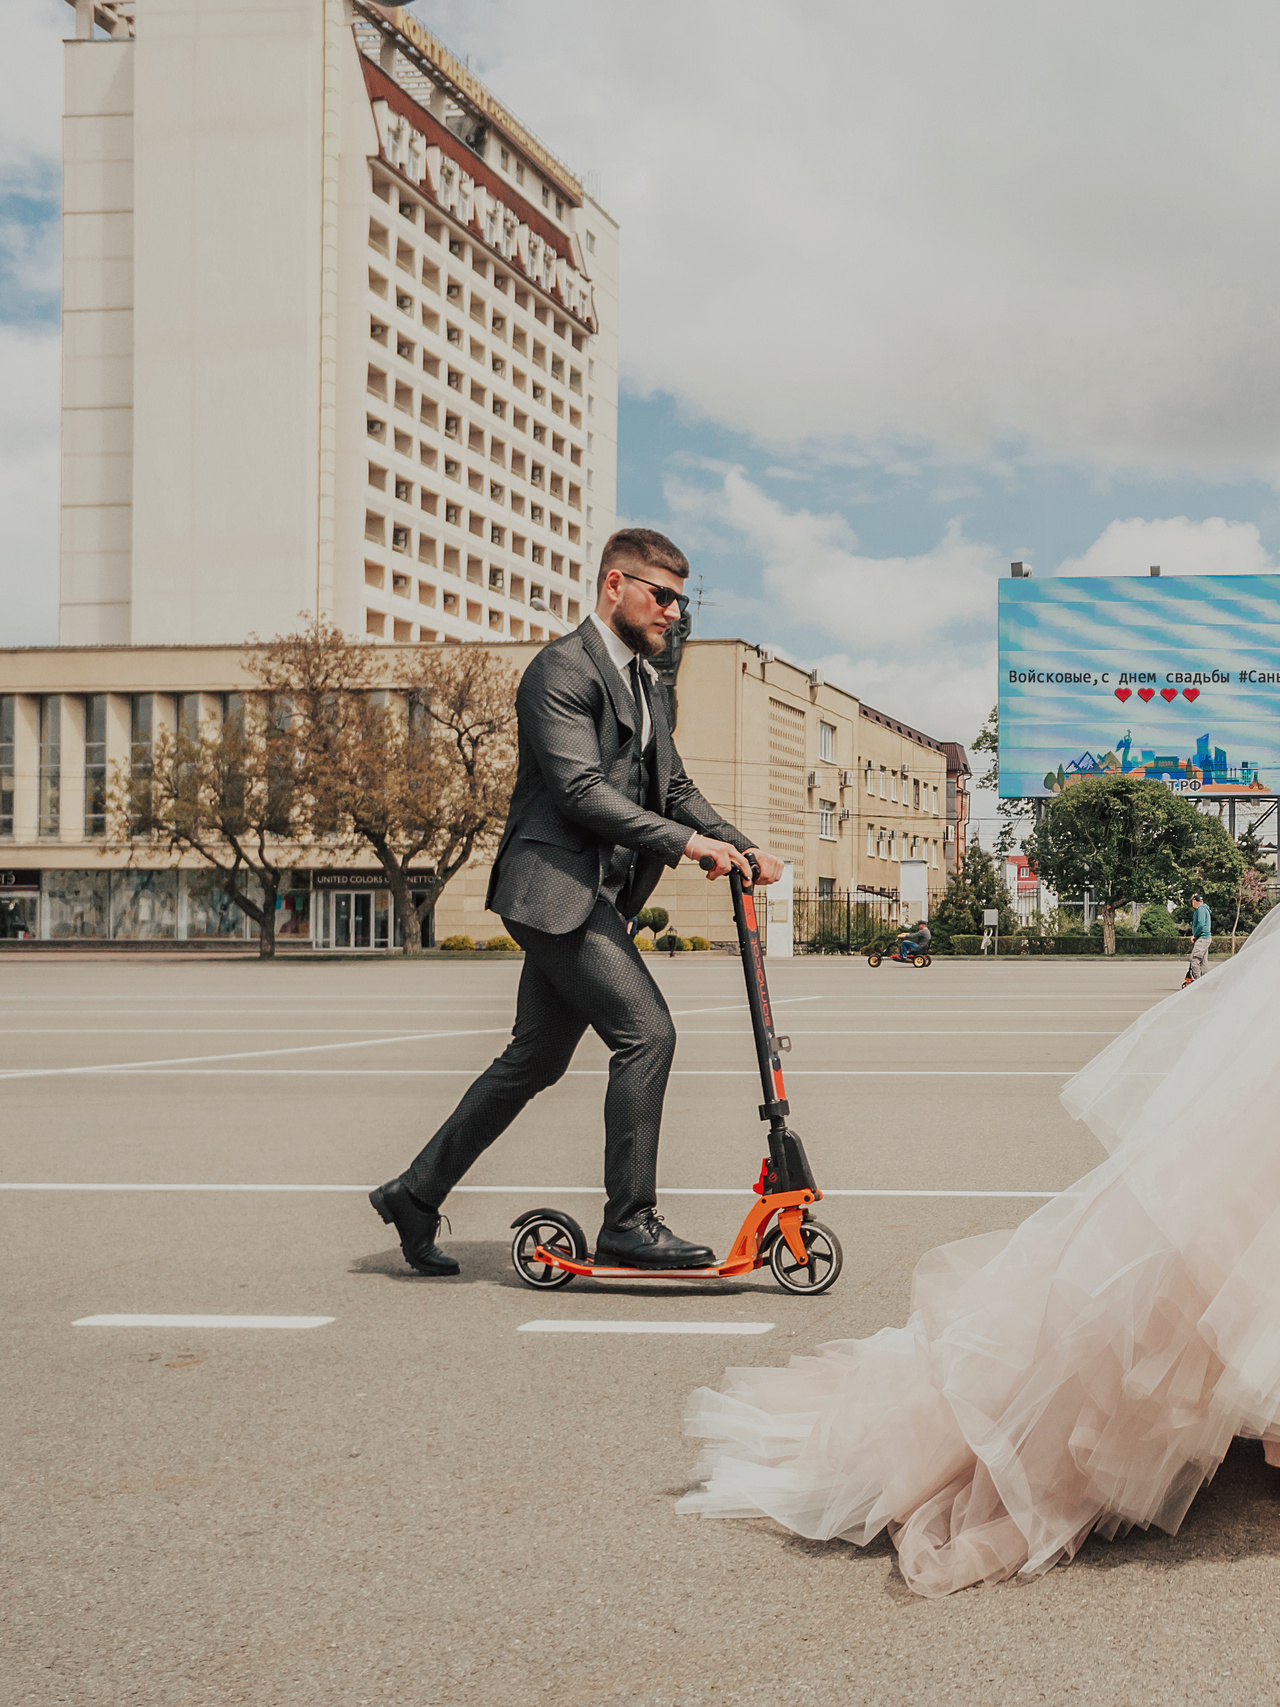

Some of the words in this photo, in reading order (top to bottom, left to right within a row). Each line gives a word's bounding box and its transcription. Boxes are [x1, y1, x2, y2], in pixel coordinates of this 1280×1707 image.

[397, 7, 491, 112] КОНТИНЕНТ
[1119, 672, 1156, 685] днем
[1166, 669, 1230, 685] свадьбы
[1168, 779, 1202, 791] Т.РФ
[317, 875, 348, 884] UNITED
[349, 875, 382, 884] COLORS
